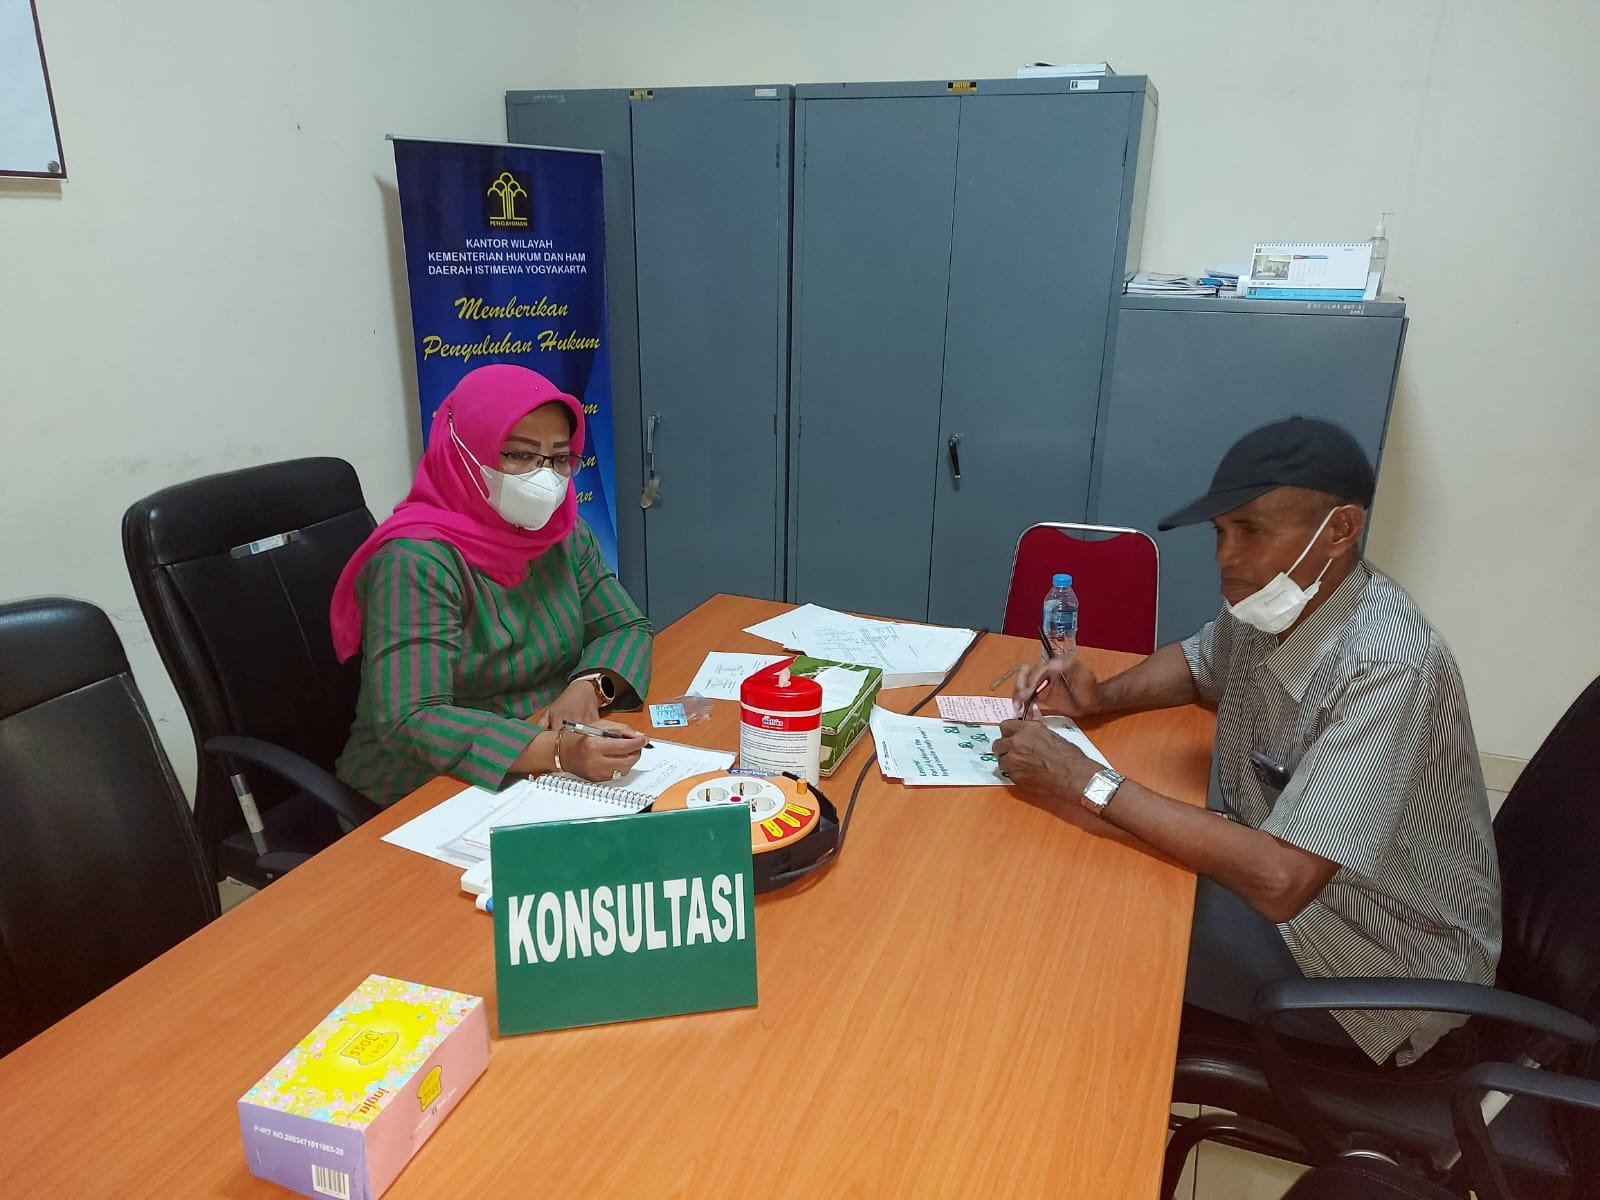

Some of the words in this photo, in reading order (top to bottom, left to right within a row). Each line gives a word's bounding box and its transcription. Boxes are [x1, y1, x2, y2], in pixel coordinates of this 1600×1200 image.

[466, 238, 509, 249] KANTOR
[510, 239, 553, 249] WILAYAH
[428, 252, 503, 262] KEMENTERIAN
[506, 252, 542, 262] HUKUM
[543, 253, 566, 262] DAN
[566, 253, 586, 262] HAM
[428, 265, 473, 275] DAERAH
[475, 265, 523, 275] ISTIMEWA
[525, 265, 587, 275] YOGYAKARTA
[454, 296, 569, 321] Memberikan
[423, 332, 532, 363] Penyuluhan
[537, 330, 601, 352] Hukum
[507, 873, 746, 966] KONSULTASI
